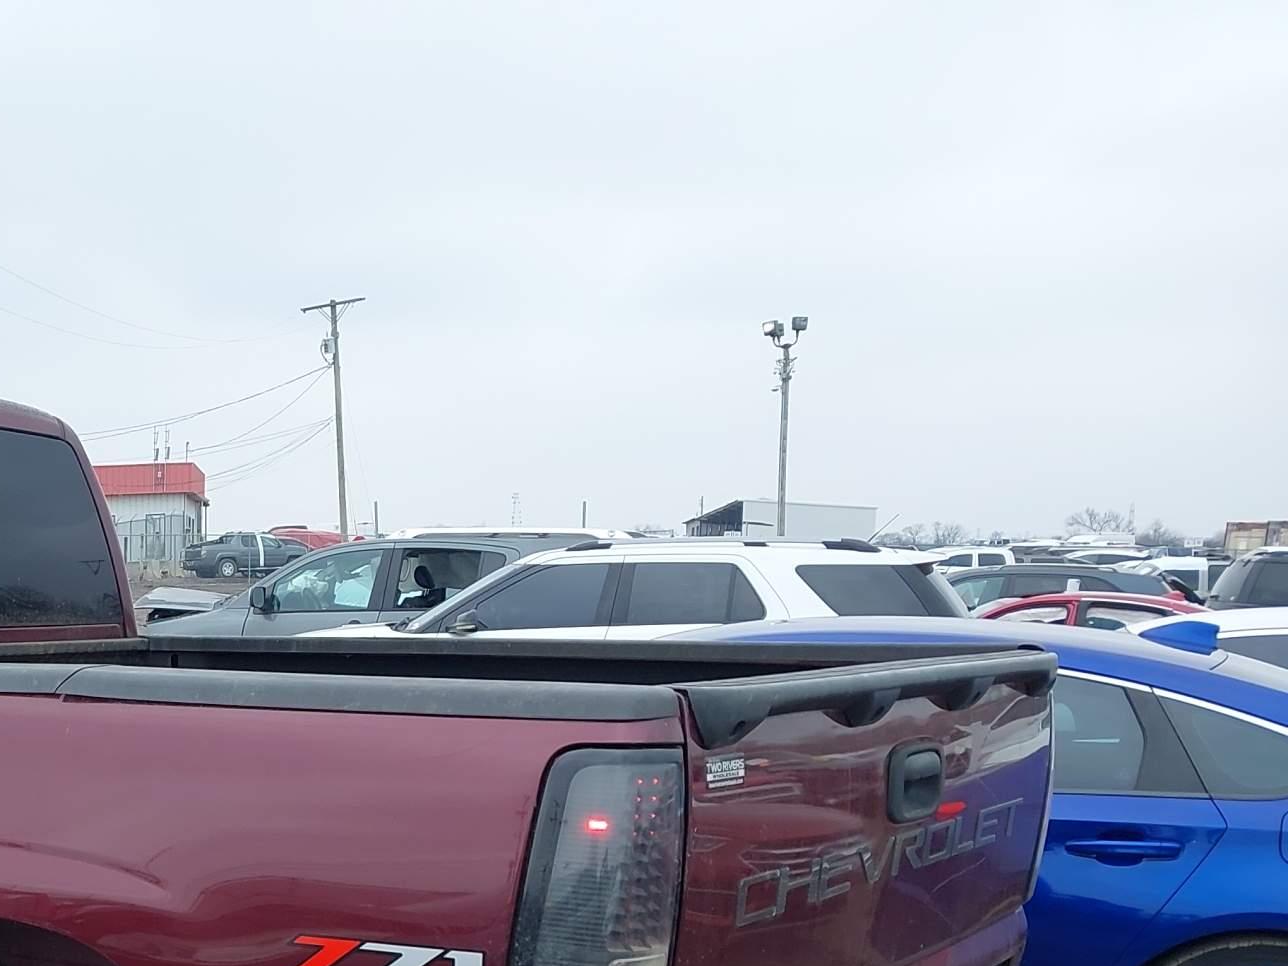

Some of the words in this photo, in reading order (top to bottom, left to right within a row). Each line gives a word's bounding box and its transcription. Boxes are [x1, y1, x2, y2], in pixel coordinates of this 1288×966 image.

[706, 762, 722, 774] TWO
[722, 758, 744, 771] RIVERS
[736, 797, 1025, 929] CHEVROLET
